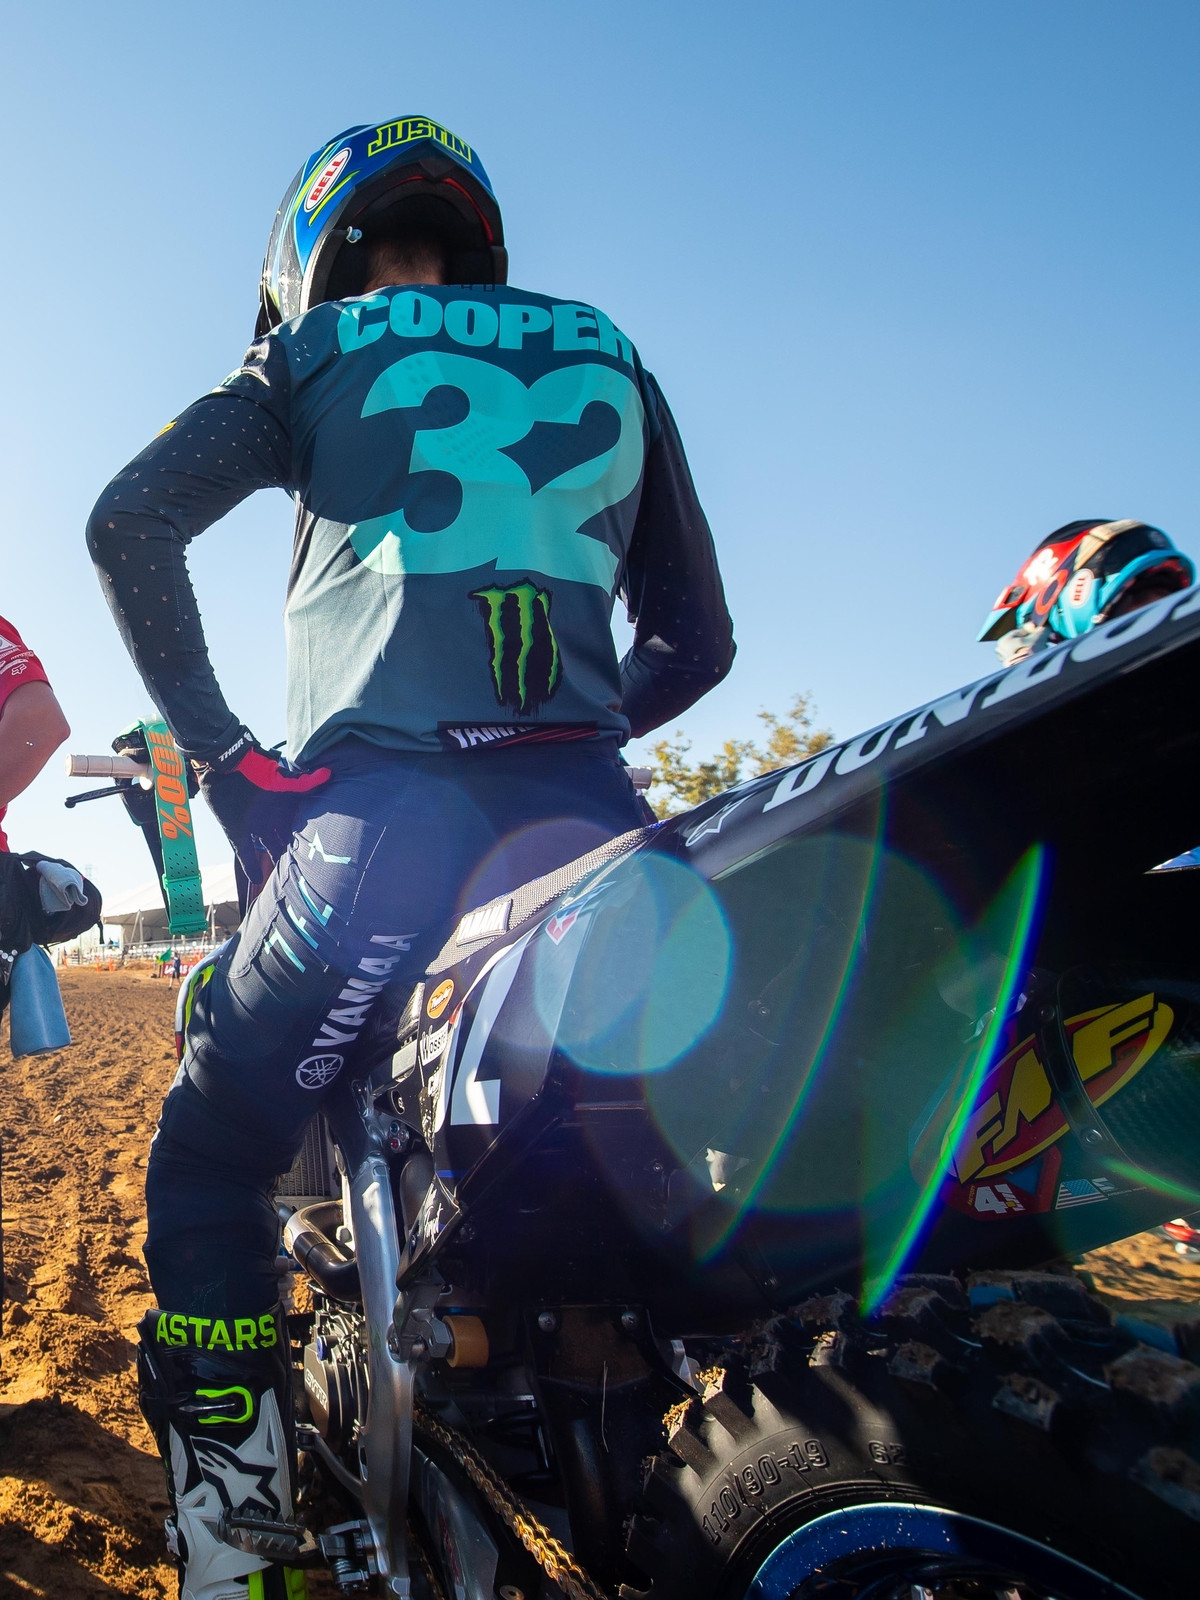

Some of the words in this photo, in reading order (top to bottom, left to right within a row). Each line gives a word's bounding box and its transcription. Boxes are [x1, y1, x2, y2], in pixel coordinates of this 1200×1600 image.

[367, 118, 472, 163] JUSTIN
[310, 156, 346, 201] BELL
[340, 351, 644, 598] 32
[1073, 576, 1087, 601] BELL
[763, 582, 1200, 813] DUNLO
[218, 737, 244, 762] THOR
[156, 1312, 278, 1352] ASTARS
[702, 1438, 830, 1545] 110/90-19
